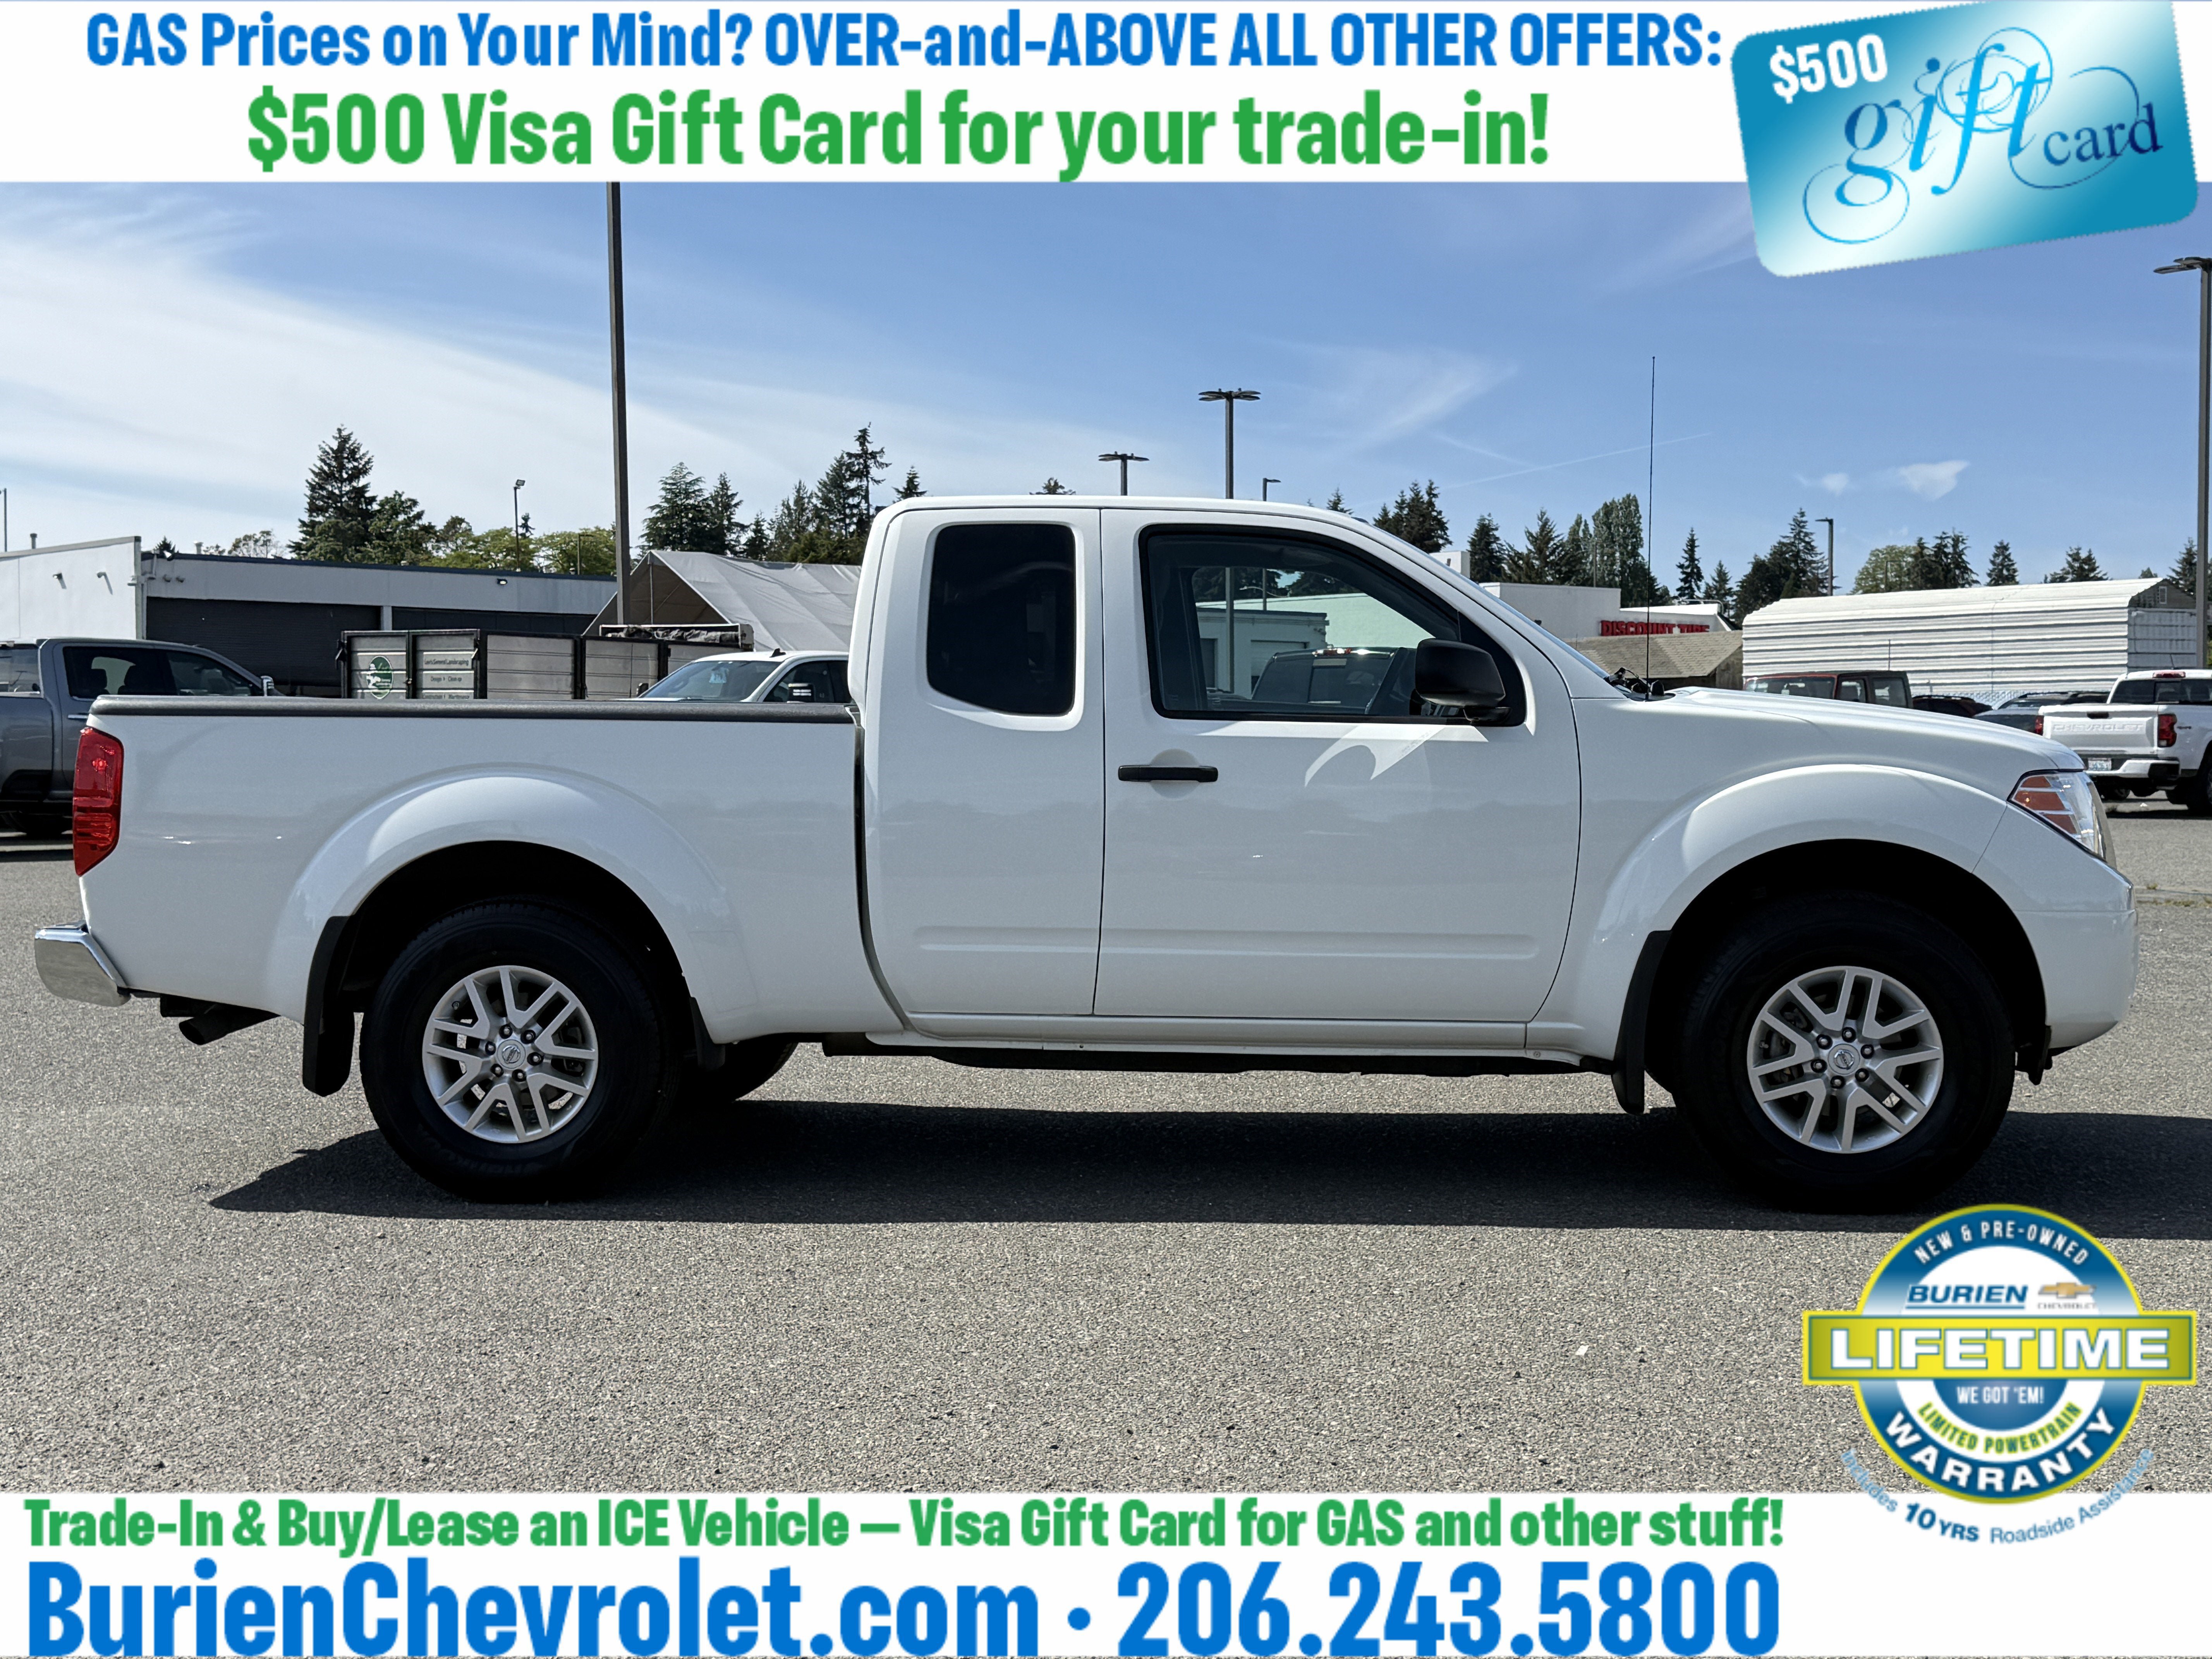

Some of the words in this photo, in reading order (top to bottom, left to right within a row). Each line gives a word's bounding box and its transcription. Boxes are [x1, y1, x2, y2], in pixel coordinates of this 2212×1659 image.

[1601, 620, 1676, 636] DISCOUNT
[1677, 624, 1710, 633] TIRE
[2053, 723, 2144, 732] CHEVROLET
